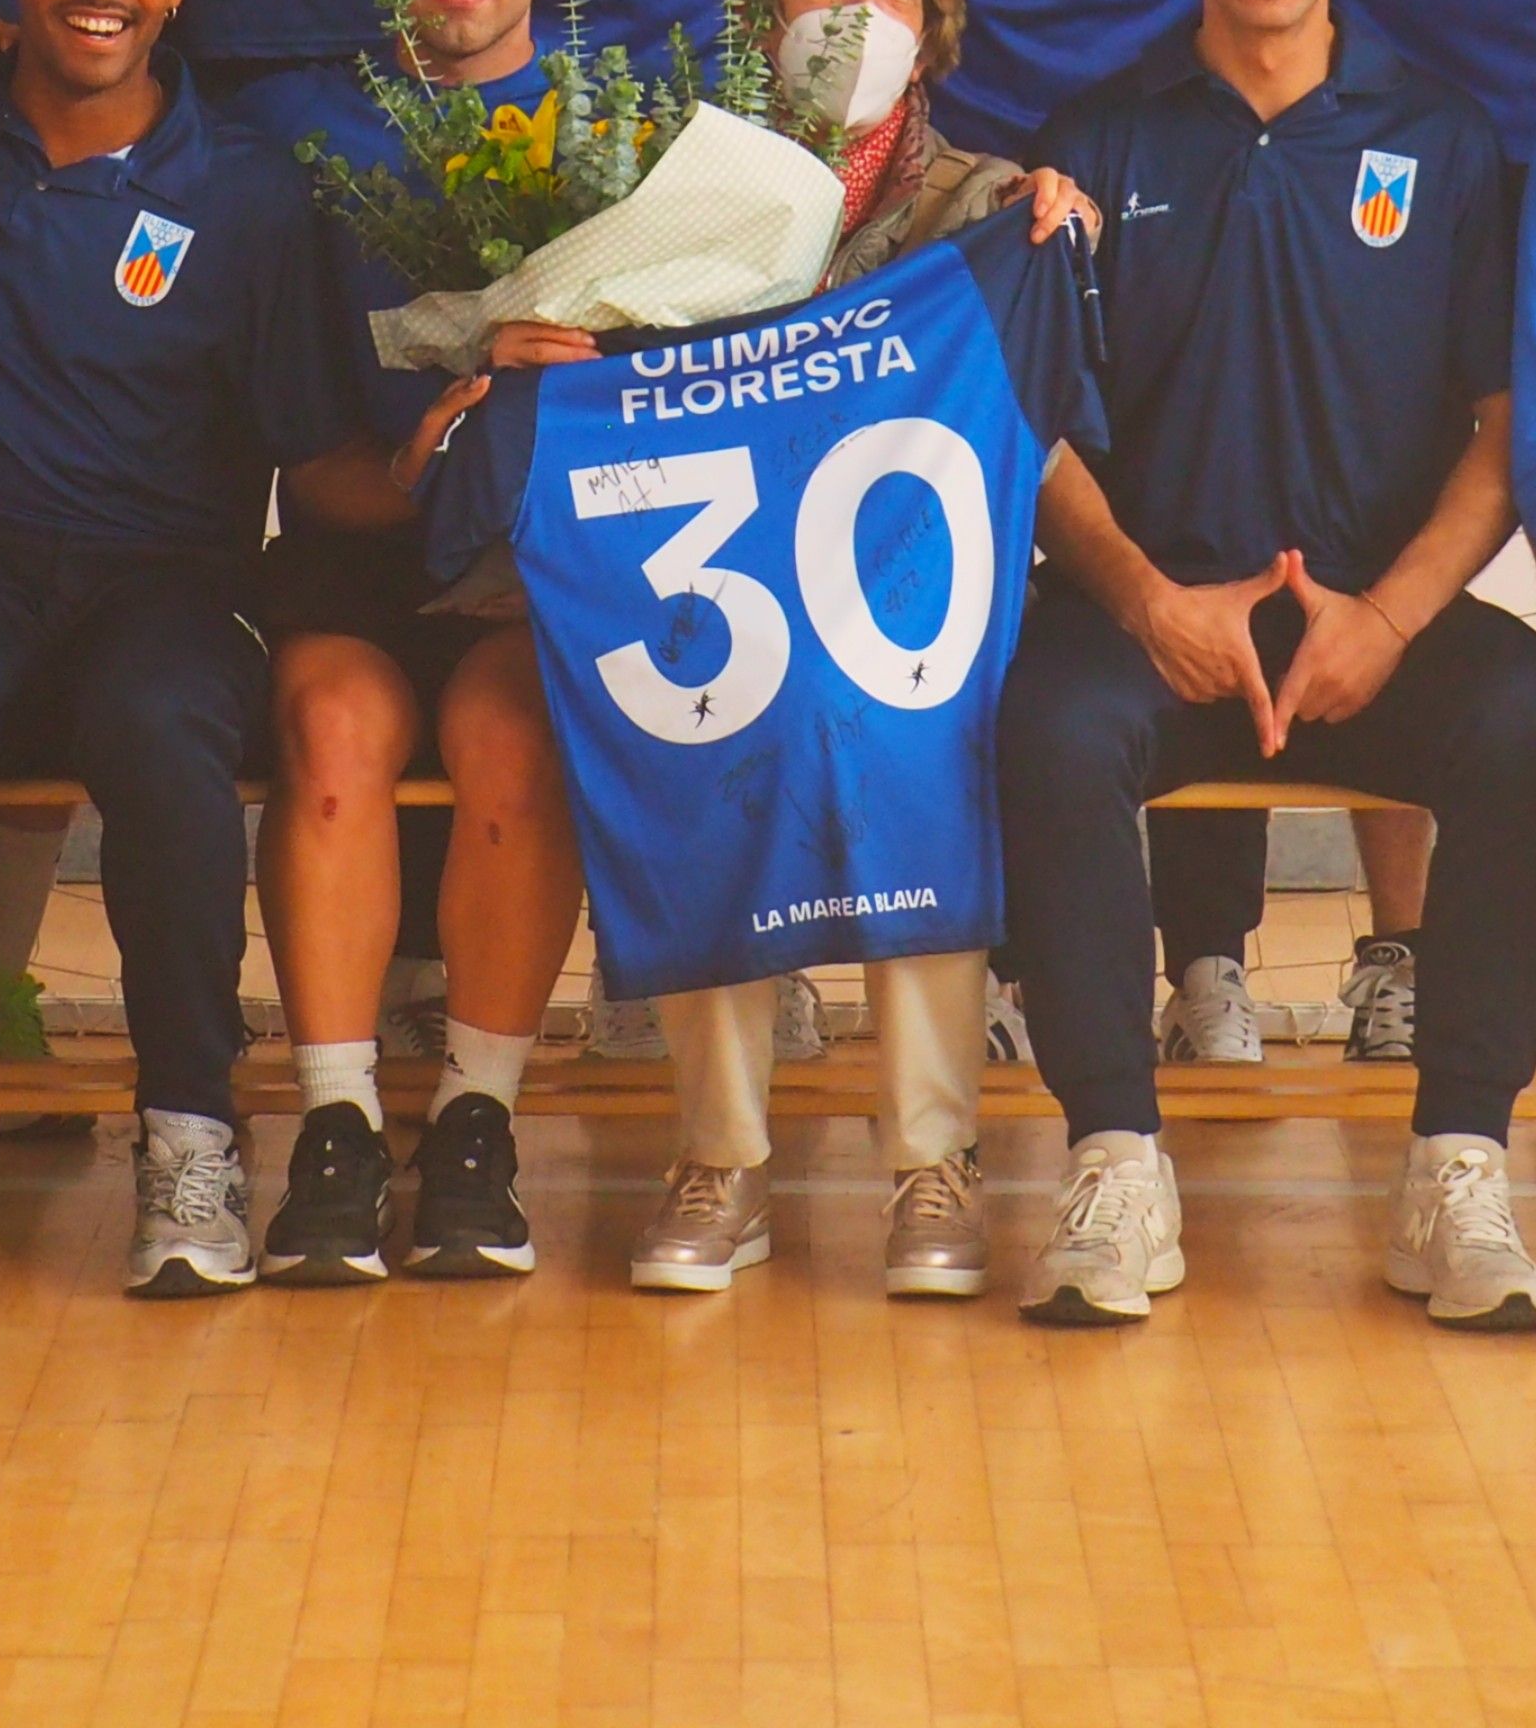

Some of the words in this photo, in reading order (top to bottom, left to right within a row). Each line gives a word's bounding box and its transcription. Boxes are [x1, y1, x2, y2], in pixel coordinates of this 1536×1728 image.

[620, 335, 917, 425] FLORESTA
[631, 298, 893, 378] OLIMPYC
[568, 417, 995, 745] 30
[752, 908, 785, 934] LA
[789, 893, 873, 924] MAREA
[874, 886, 939, 913] BLAVA
